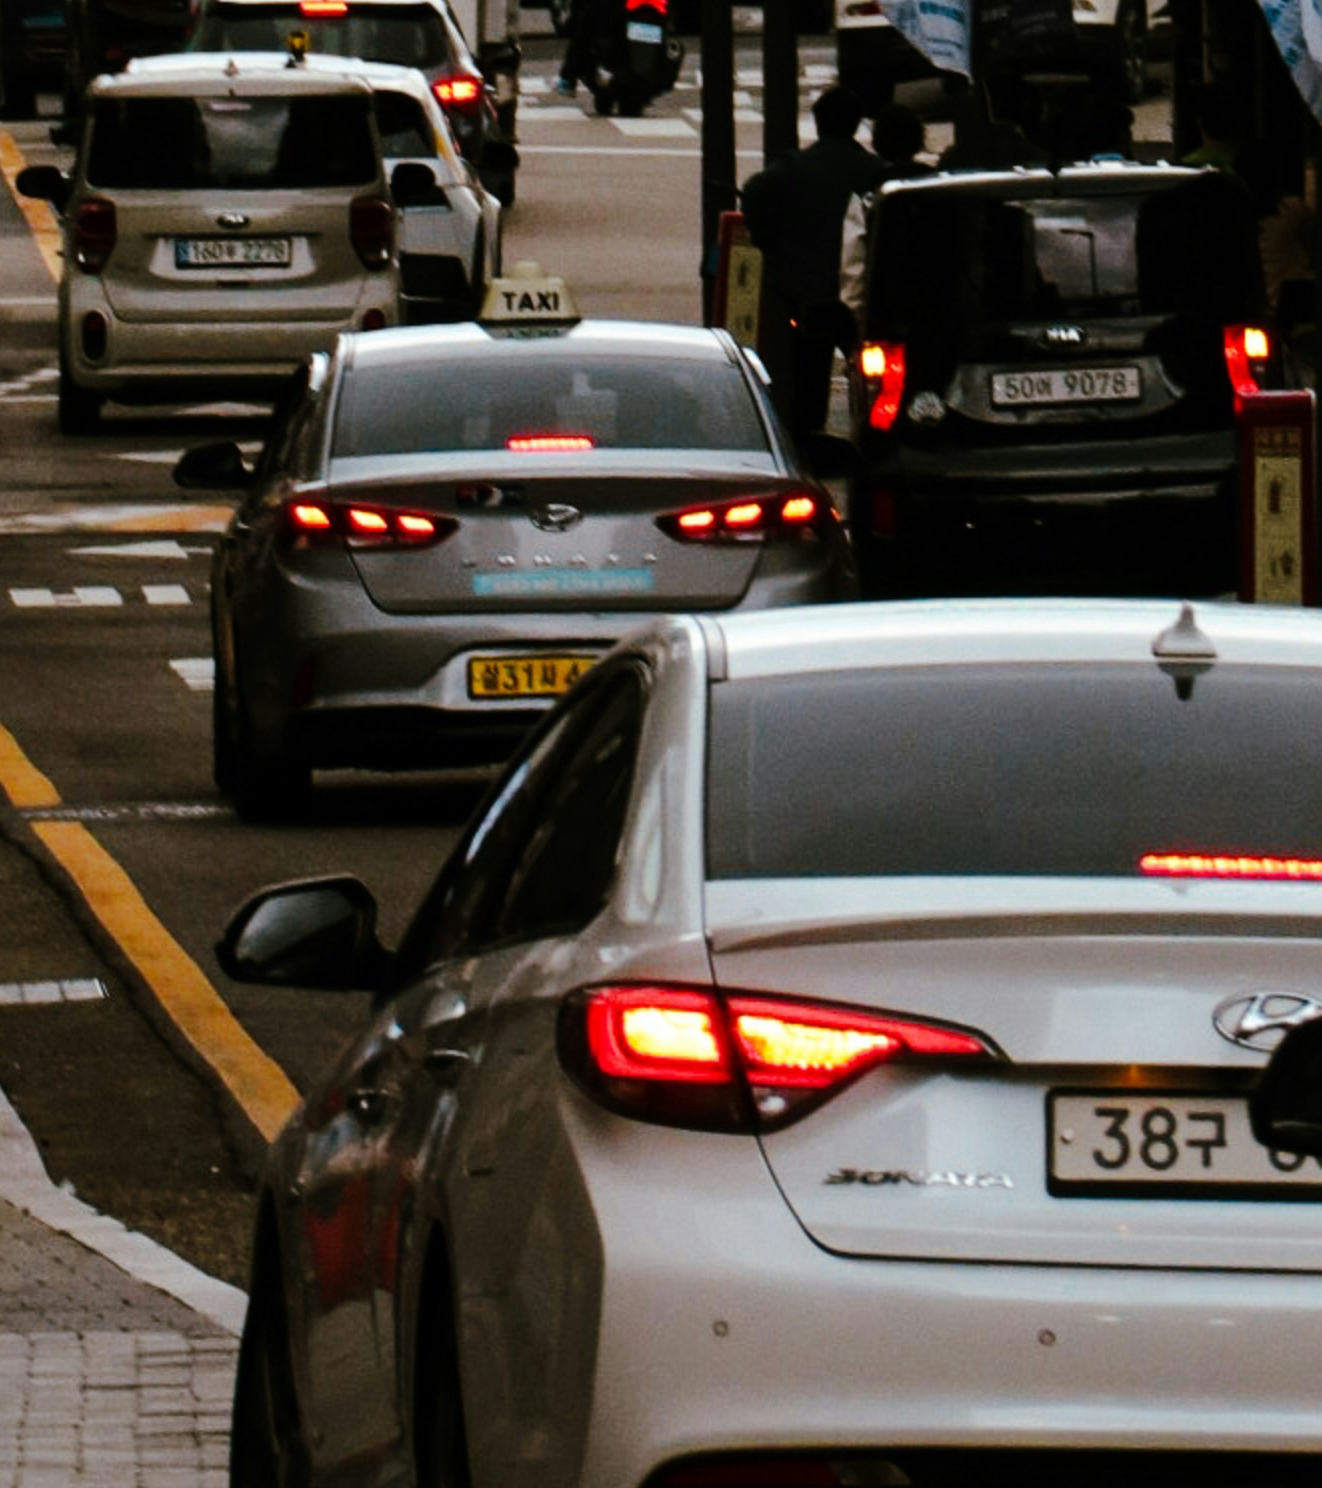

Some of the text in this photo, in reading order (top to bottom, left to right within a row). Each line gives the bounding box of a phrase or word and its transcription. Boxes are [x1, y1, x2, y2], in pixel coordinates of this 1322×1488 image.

[502, 290, 561, 313] TAXI
[1064, 371, 1127, 397] 9078
[1093, 1106, 1226, 1169] 38구
